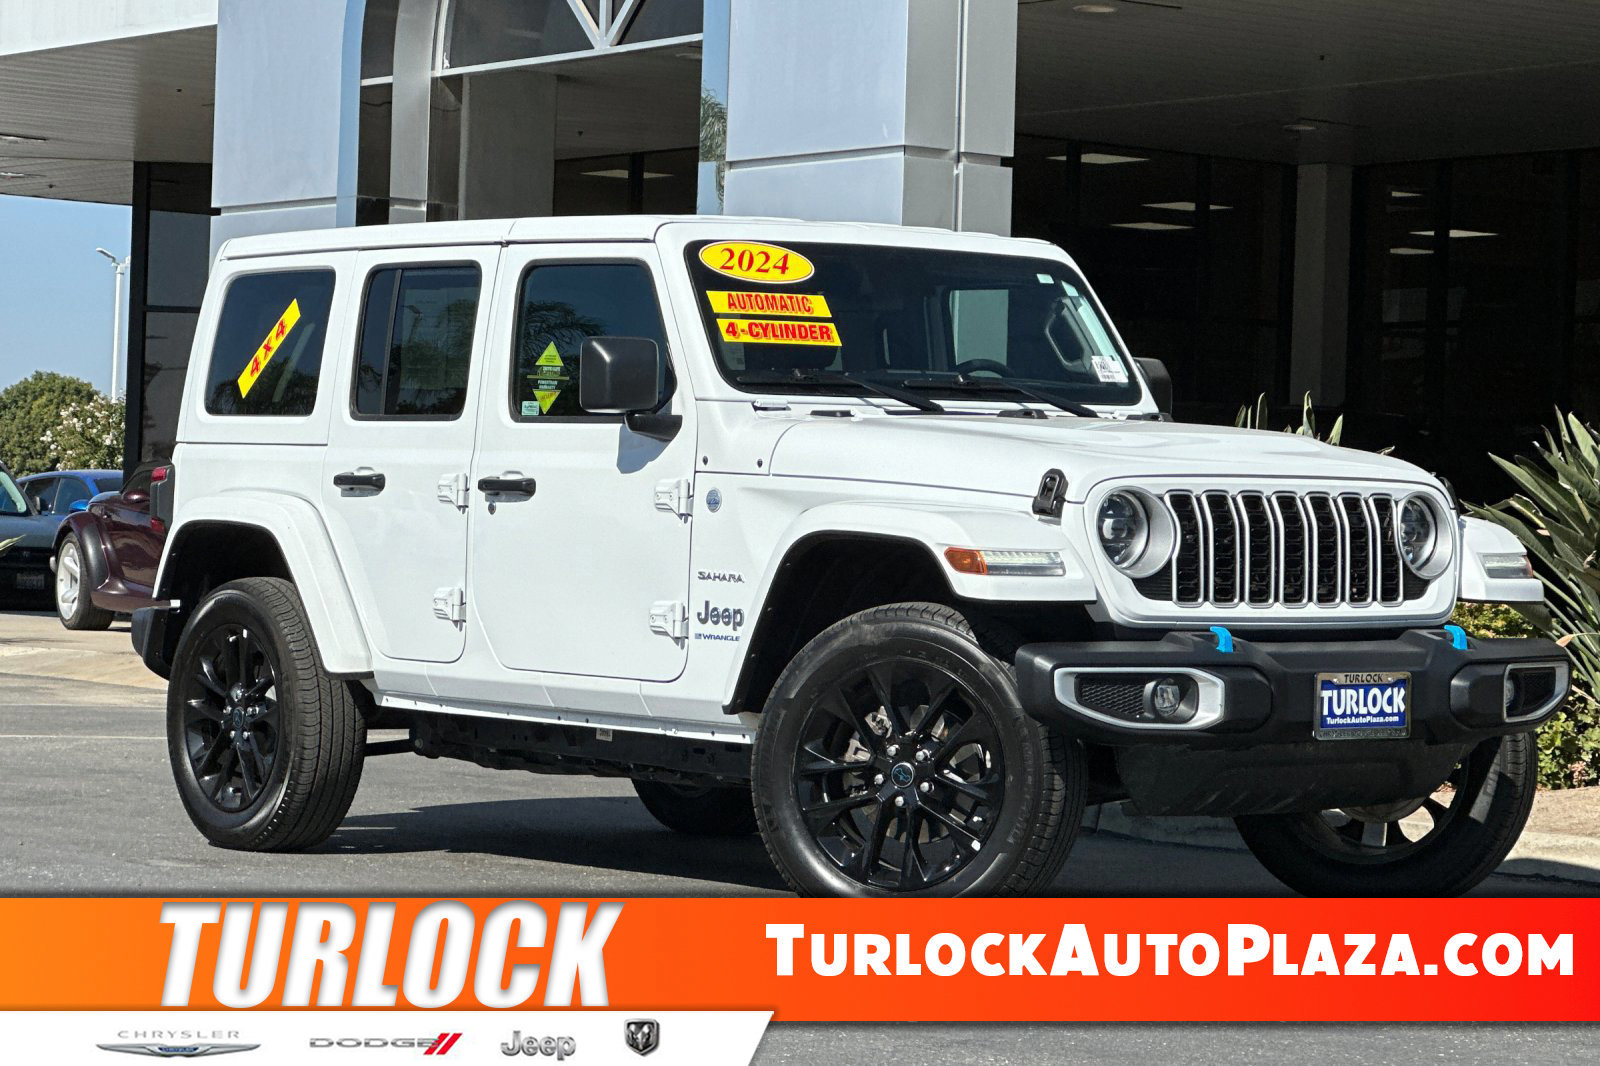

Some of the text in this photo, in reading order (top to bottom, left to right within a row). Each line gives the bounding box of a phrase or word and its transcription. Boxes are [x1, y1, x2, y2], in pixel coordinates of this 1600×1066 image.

[719, 247, 790, 275] 2024
[727, 293, 813, 313] AUTOMATIC
[726, 321, 834, 342] 4-CYLINDER
[697, 571, 745, 584] SAHARA
[696, 599, 745, 632] Jeep
[1344, 673, 1383, 684] TURLOCK
[1320, 687, 1406, 716] TURLOCK
[1326, 715, 1400, 725] TurlockAutoPlaza.com
